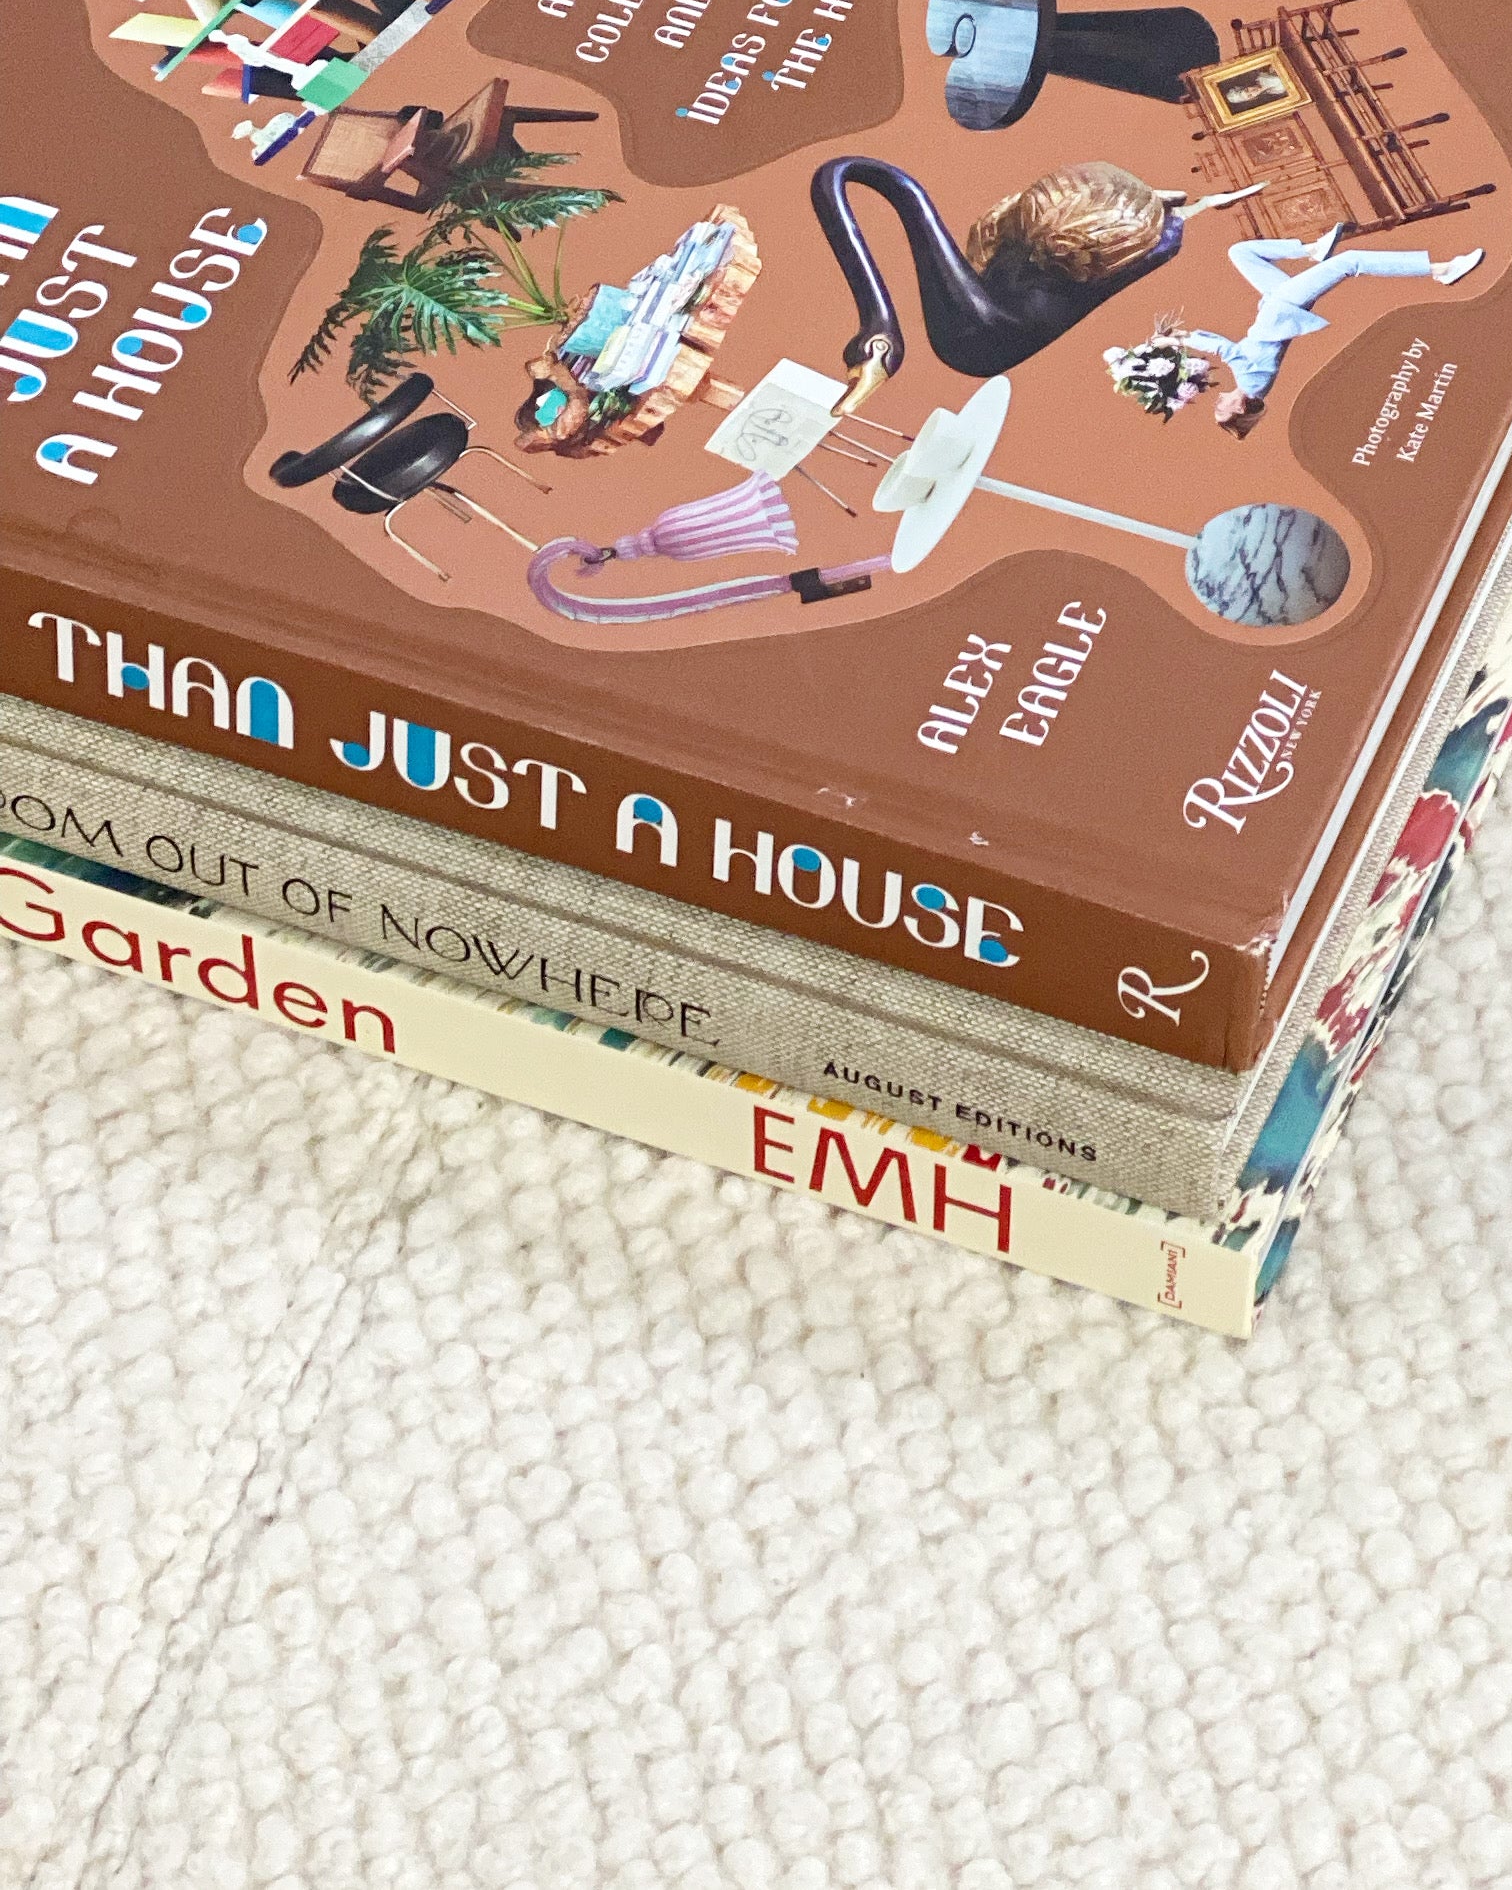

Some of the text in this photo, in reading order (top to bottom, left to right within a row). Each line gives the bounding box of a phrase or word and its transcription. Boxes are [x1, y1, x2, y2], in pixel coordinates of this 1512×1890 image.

[675, 32, 766, 125] IDEAS
[762, 28, 832, 90] THE
[0, 224, 138, 402] JUST
[35, 207, 268, 485] A HOUSE
[1351, 337, 1431, 466] Photography by
[1396, 363, 1458, 462] Kate Martin
[917, 633, 1012, 754] ALEX
[1000, 600, 1107, 746] EAGLE
[1280, 689, 1322, 760] NEW YORK
[27, 612, 1025, 968] THAN JUST A HOUSE
[1183, 669, 1307, 835] RIZZOLI
[0, 789, 721, 1046] OM OUT OF NOWHERE
[0, 867, 396, 1054] Garden
[1117, 949, 1210, 1026] R
[753, 1105, 1012, 1254] EMH
[822, 1061, 1098, 1163] AUGUST EDITIONS
